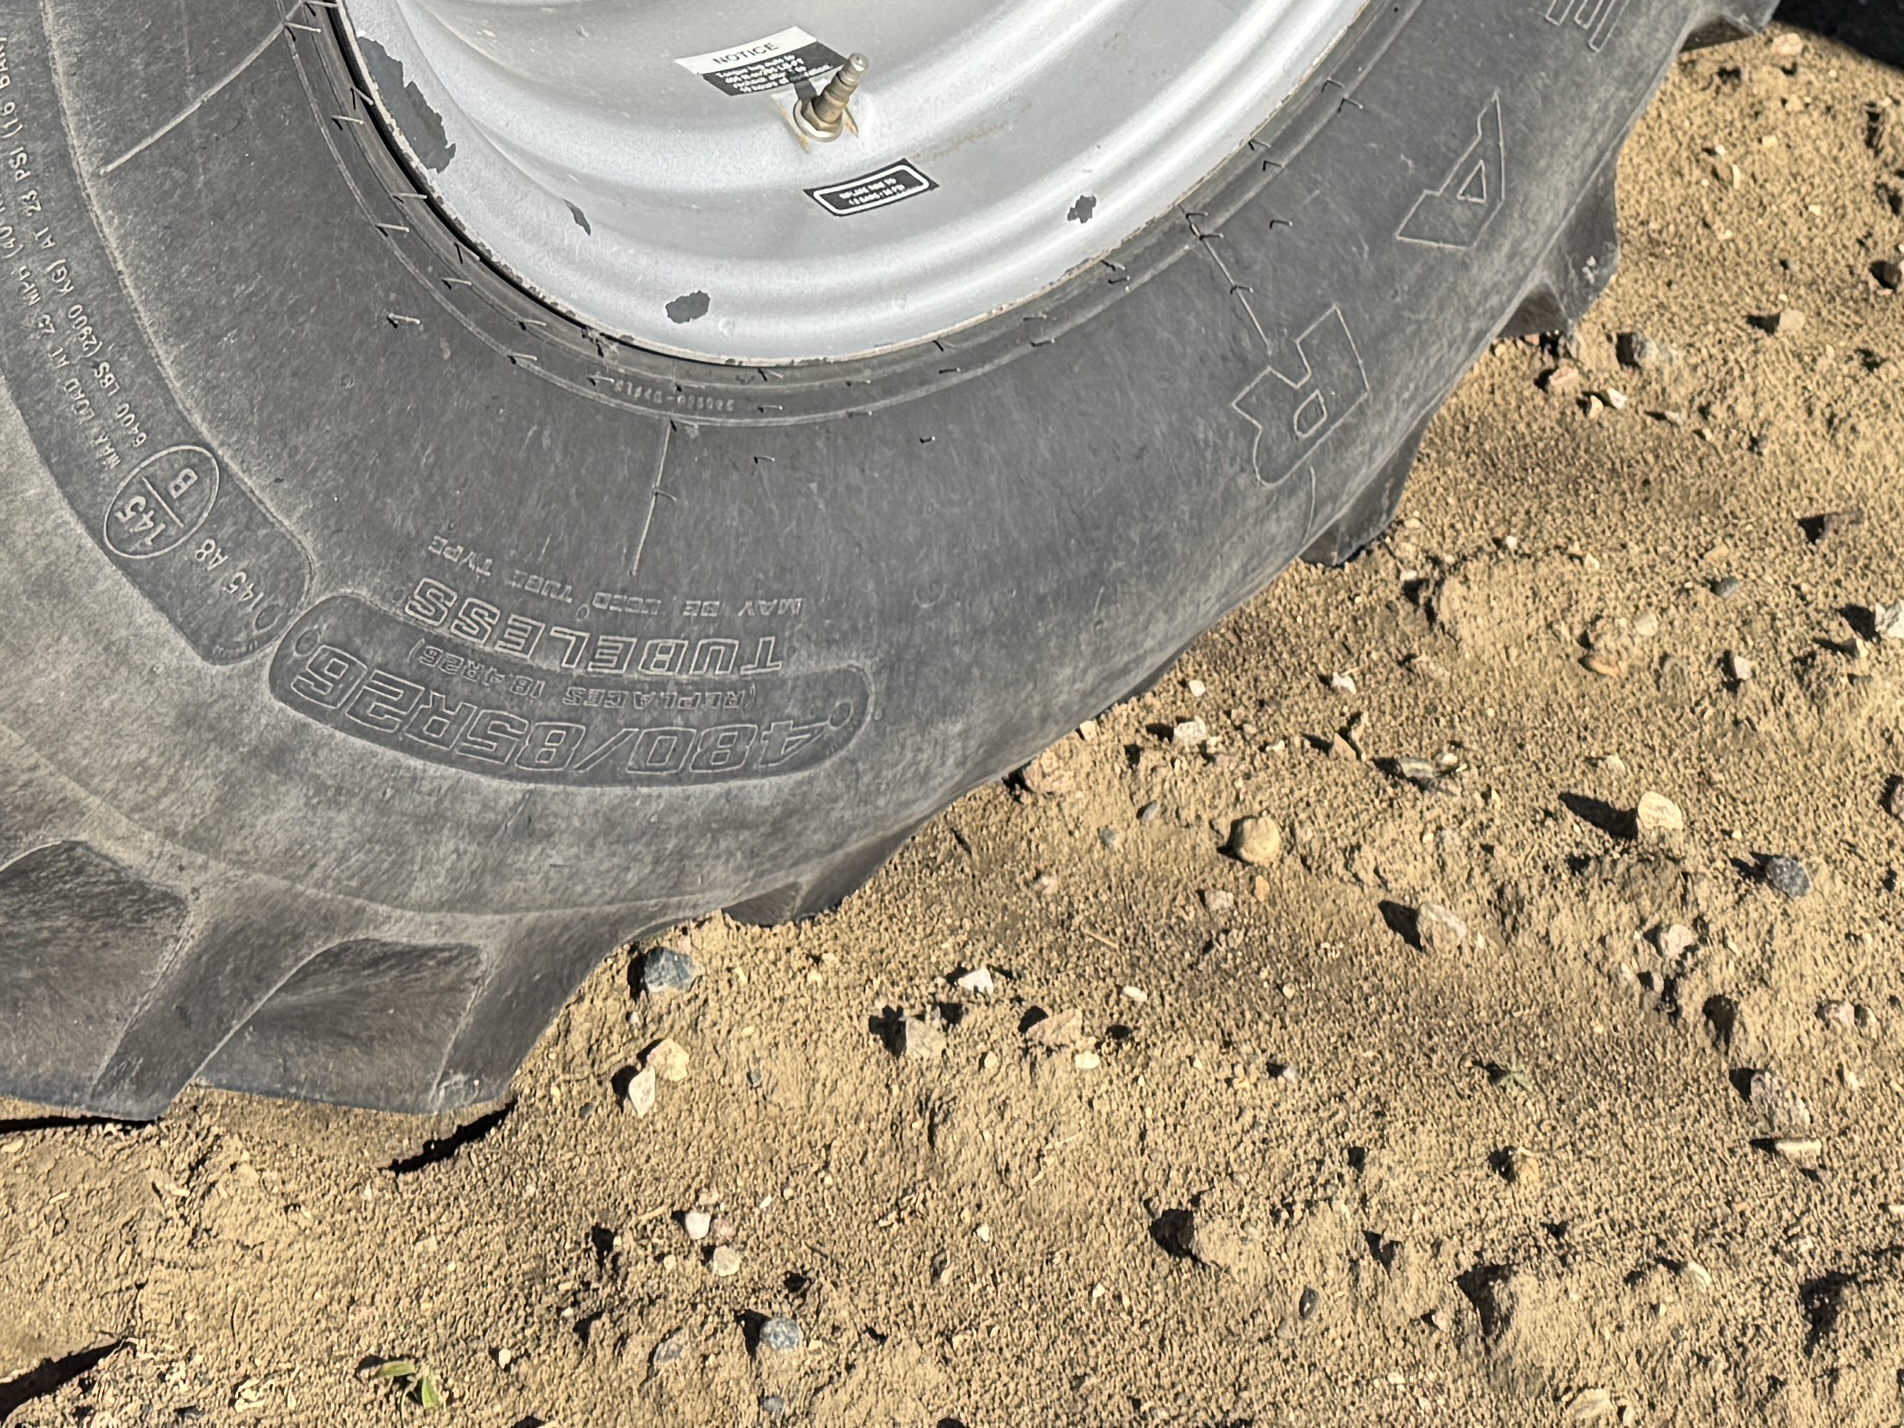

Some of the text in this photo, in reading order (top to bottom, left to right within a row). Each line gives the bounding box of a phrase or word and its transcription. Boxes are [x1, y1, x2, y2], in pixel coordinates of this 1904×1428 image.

[712, 42, 779, 65] NOTICE
[6, 145, 31, 179] PSI
[18, 188, 42, 216] 23
[31, 225, 55, 249] AT
[10, 262, 42, 307] MPH
[40, 257, 74, 297] KG)
[29, 311, 56, 337] 25
[62, 301, 102, 359] (2900
[47, 345, 69, 370] AT
[92, 358, 121, 397] LBS
[62, 375, 96, 424] LOAD
[113, 400, 147, 449] 6400
[163, 464, 200, 500] B
[112, 489, 172, 549] 145
[190, 534, 230, 574] A8
[428, 534, 494, 577] TYPE
[220, 567, 267, 614] 145
[683, 598, 720, 618] BE
[738, 597, 803, 617] MAY
[404, 576, 784, 676] TUBELESS
[407, 637, 757, 710] (REPLACES 18.4R26)
[289, 643, 831, 775] 480/85R26
